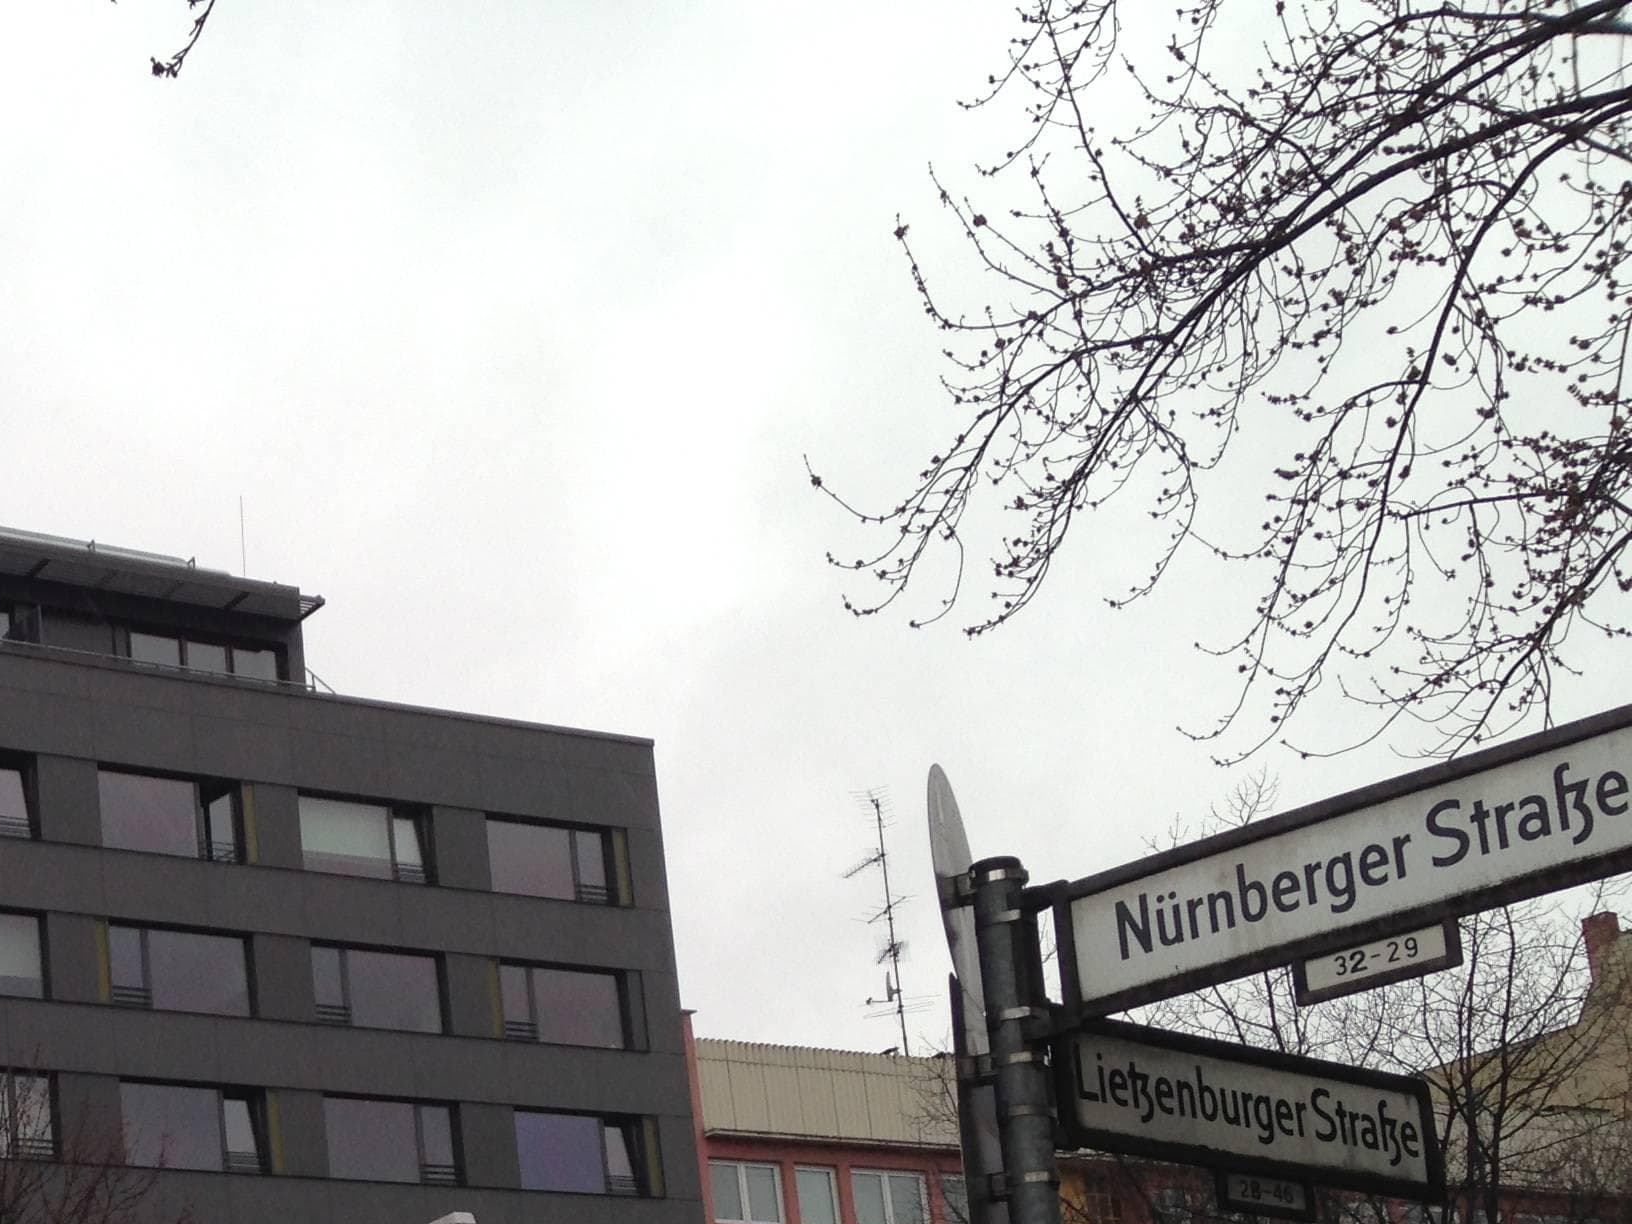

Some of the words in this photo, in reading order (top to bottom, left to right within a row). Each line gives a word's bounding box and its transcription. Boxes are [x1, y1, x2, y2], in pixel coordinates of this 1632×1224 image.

[1115, 834, 1411, 961] Nürnberger
[1425, 762, 1629, 868] Straße
[1334, 937, 1419, 976] 32-29
[1076, 1043, 1308, 1145] Lietzenburger
[1310, 1087, 1420, 1167] Straße
